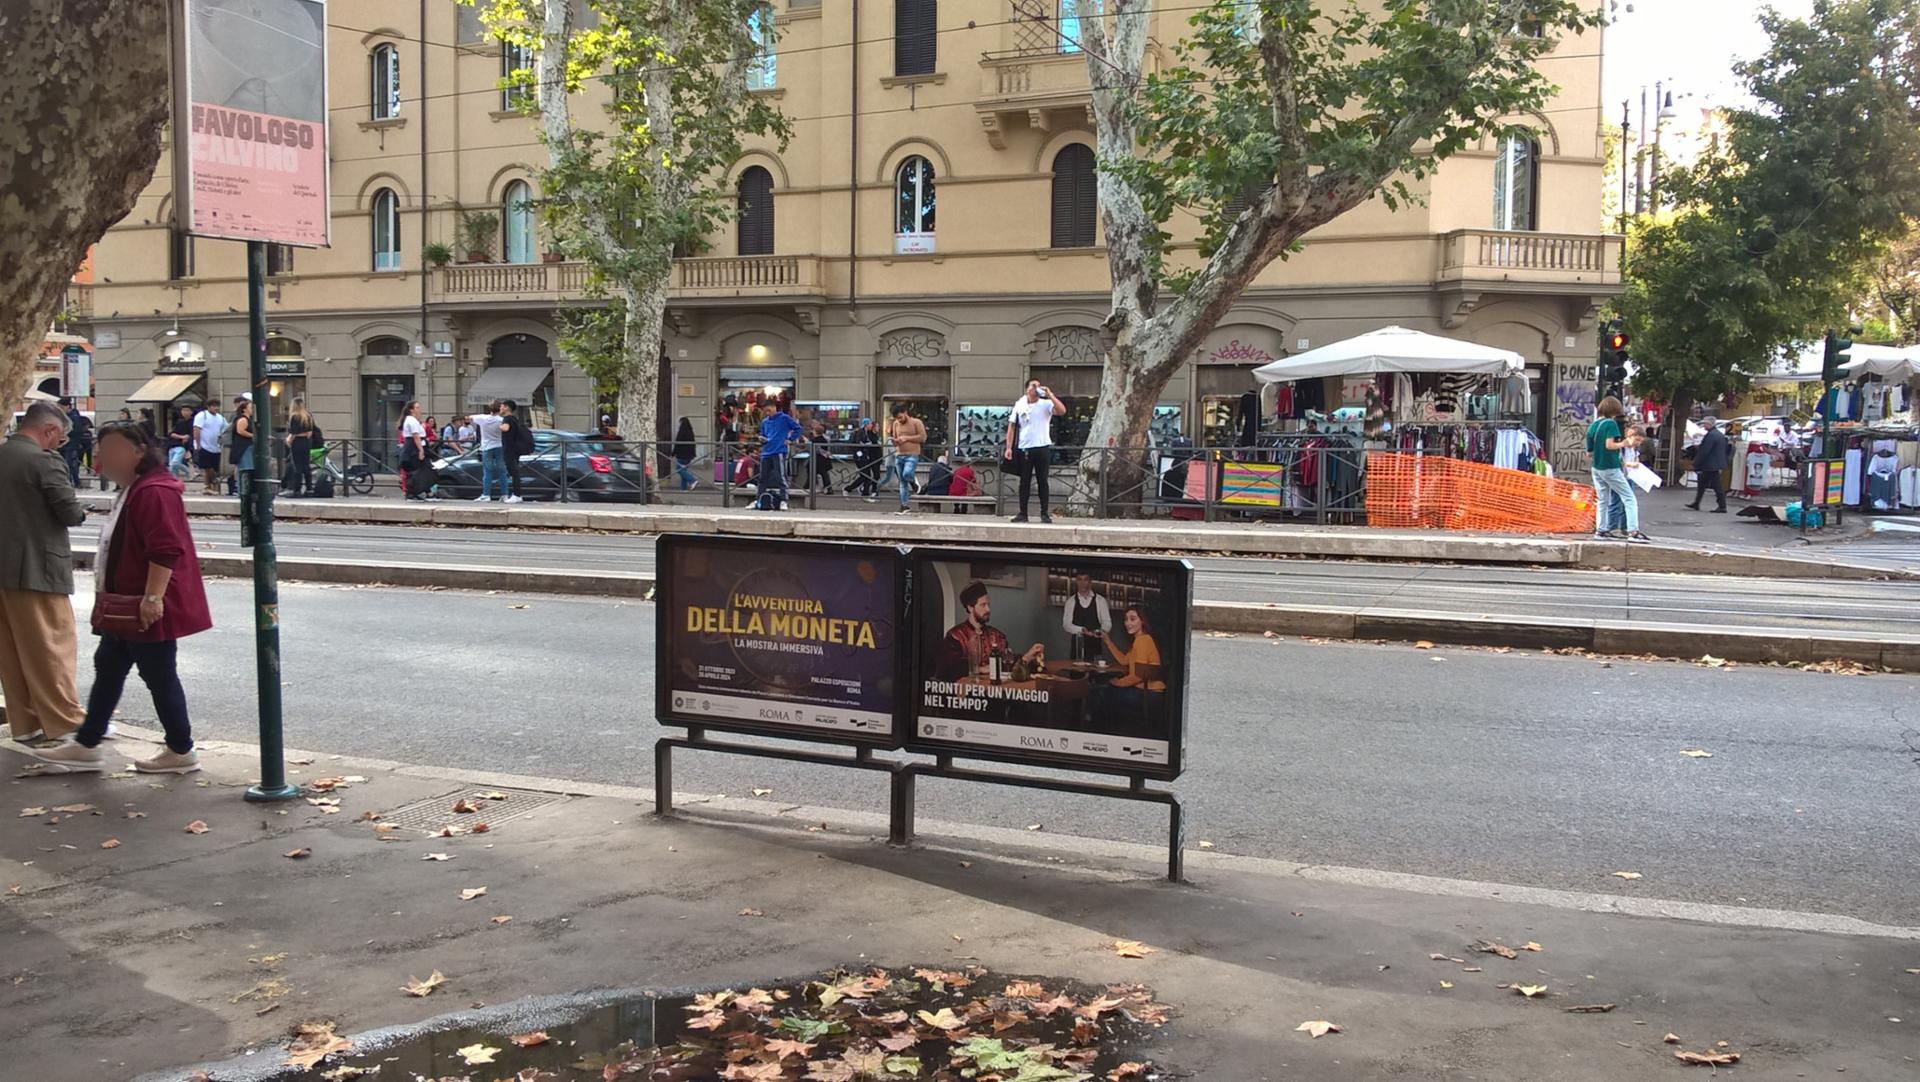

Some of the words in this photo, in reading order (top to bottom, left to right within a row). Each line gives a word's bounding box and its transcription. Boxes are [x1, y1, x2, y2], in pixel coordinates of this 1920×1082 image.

[191, 105, 314, 150] FAVOLOSO
[1560, 363, 1596, 381] PONE
[734, 593, 824, 614] L'AVVENTURA
[687, 606, 766, 635] DELLA
[770, 612, 876, 649] MONETA
[734, 638, 745, 648] LA
[747, 639, 779, 651] MOSTRA
[779, 641, 824, 656] IMMERSIVA
[924, 680, 963, 695] PRONTI
[965, 684, 985, 697] PER
[987, 686, 1003, 699] UN
[1004, 687, 1049, 704] VIAGGIO
[924, 694, 945, 708] NEL
[946, 695, 989, 711] TEMPO?
[760, 709, 790, 720] ROMA
[1020, 735, 1054, 749] ROMA
